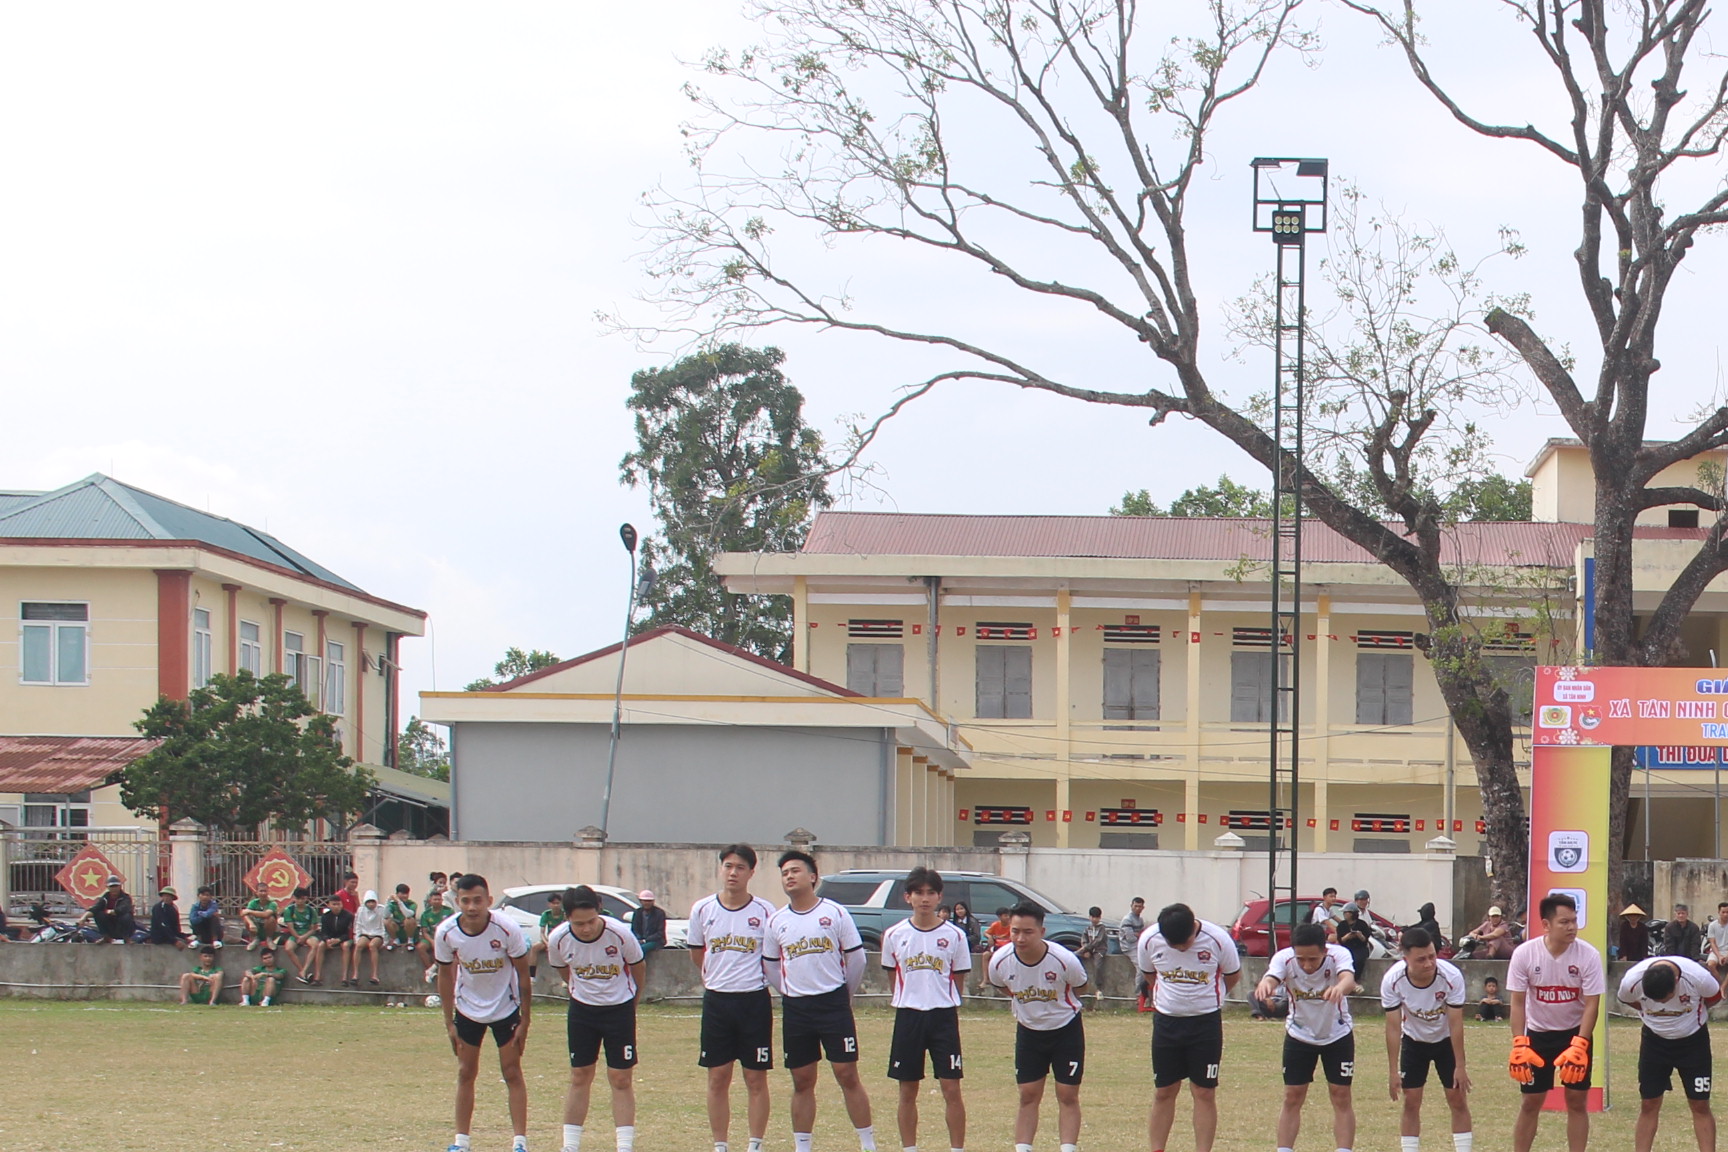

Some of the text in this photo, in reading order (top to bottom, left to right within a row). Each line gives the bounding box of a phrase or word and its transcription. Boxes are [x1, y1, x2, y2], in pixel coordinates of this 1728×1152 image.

[1609, 699, 1632, 718] XÃ
[1638, 699, 1670, 718] TÂN
[1676, 701, 1716, 718] NINH
[1656, 746, 1682, 763] THI
[843, 1036, 856, 1052] 12
[623, 1045, 632, 1060] 6
[756, 1046, 769, 1062] 15
[950, 1054, 962, 1070] 14
[1069, 1061, 1078, 1076] 7
[1206, 1063, 1218, 1079] 10
[1694, 1077, 1711, 1092] 95
